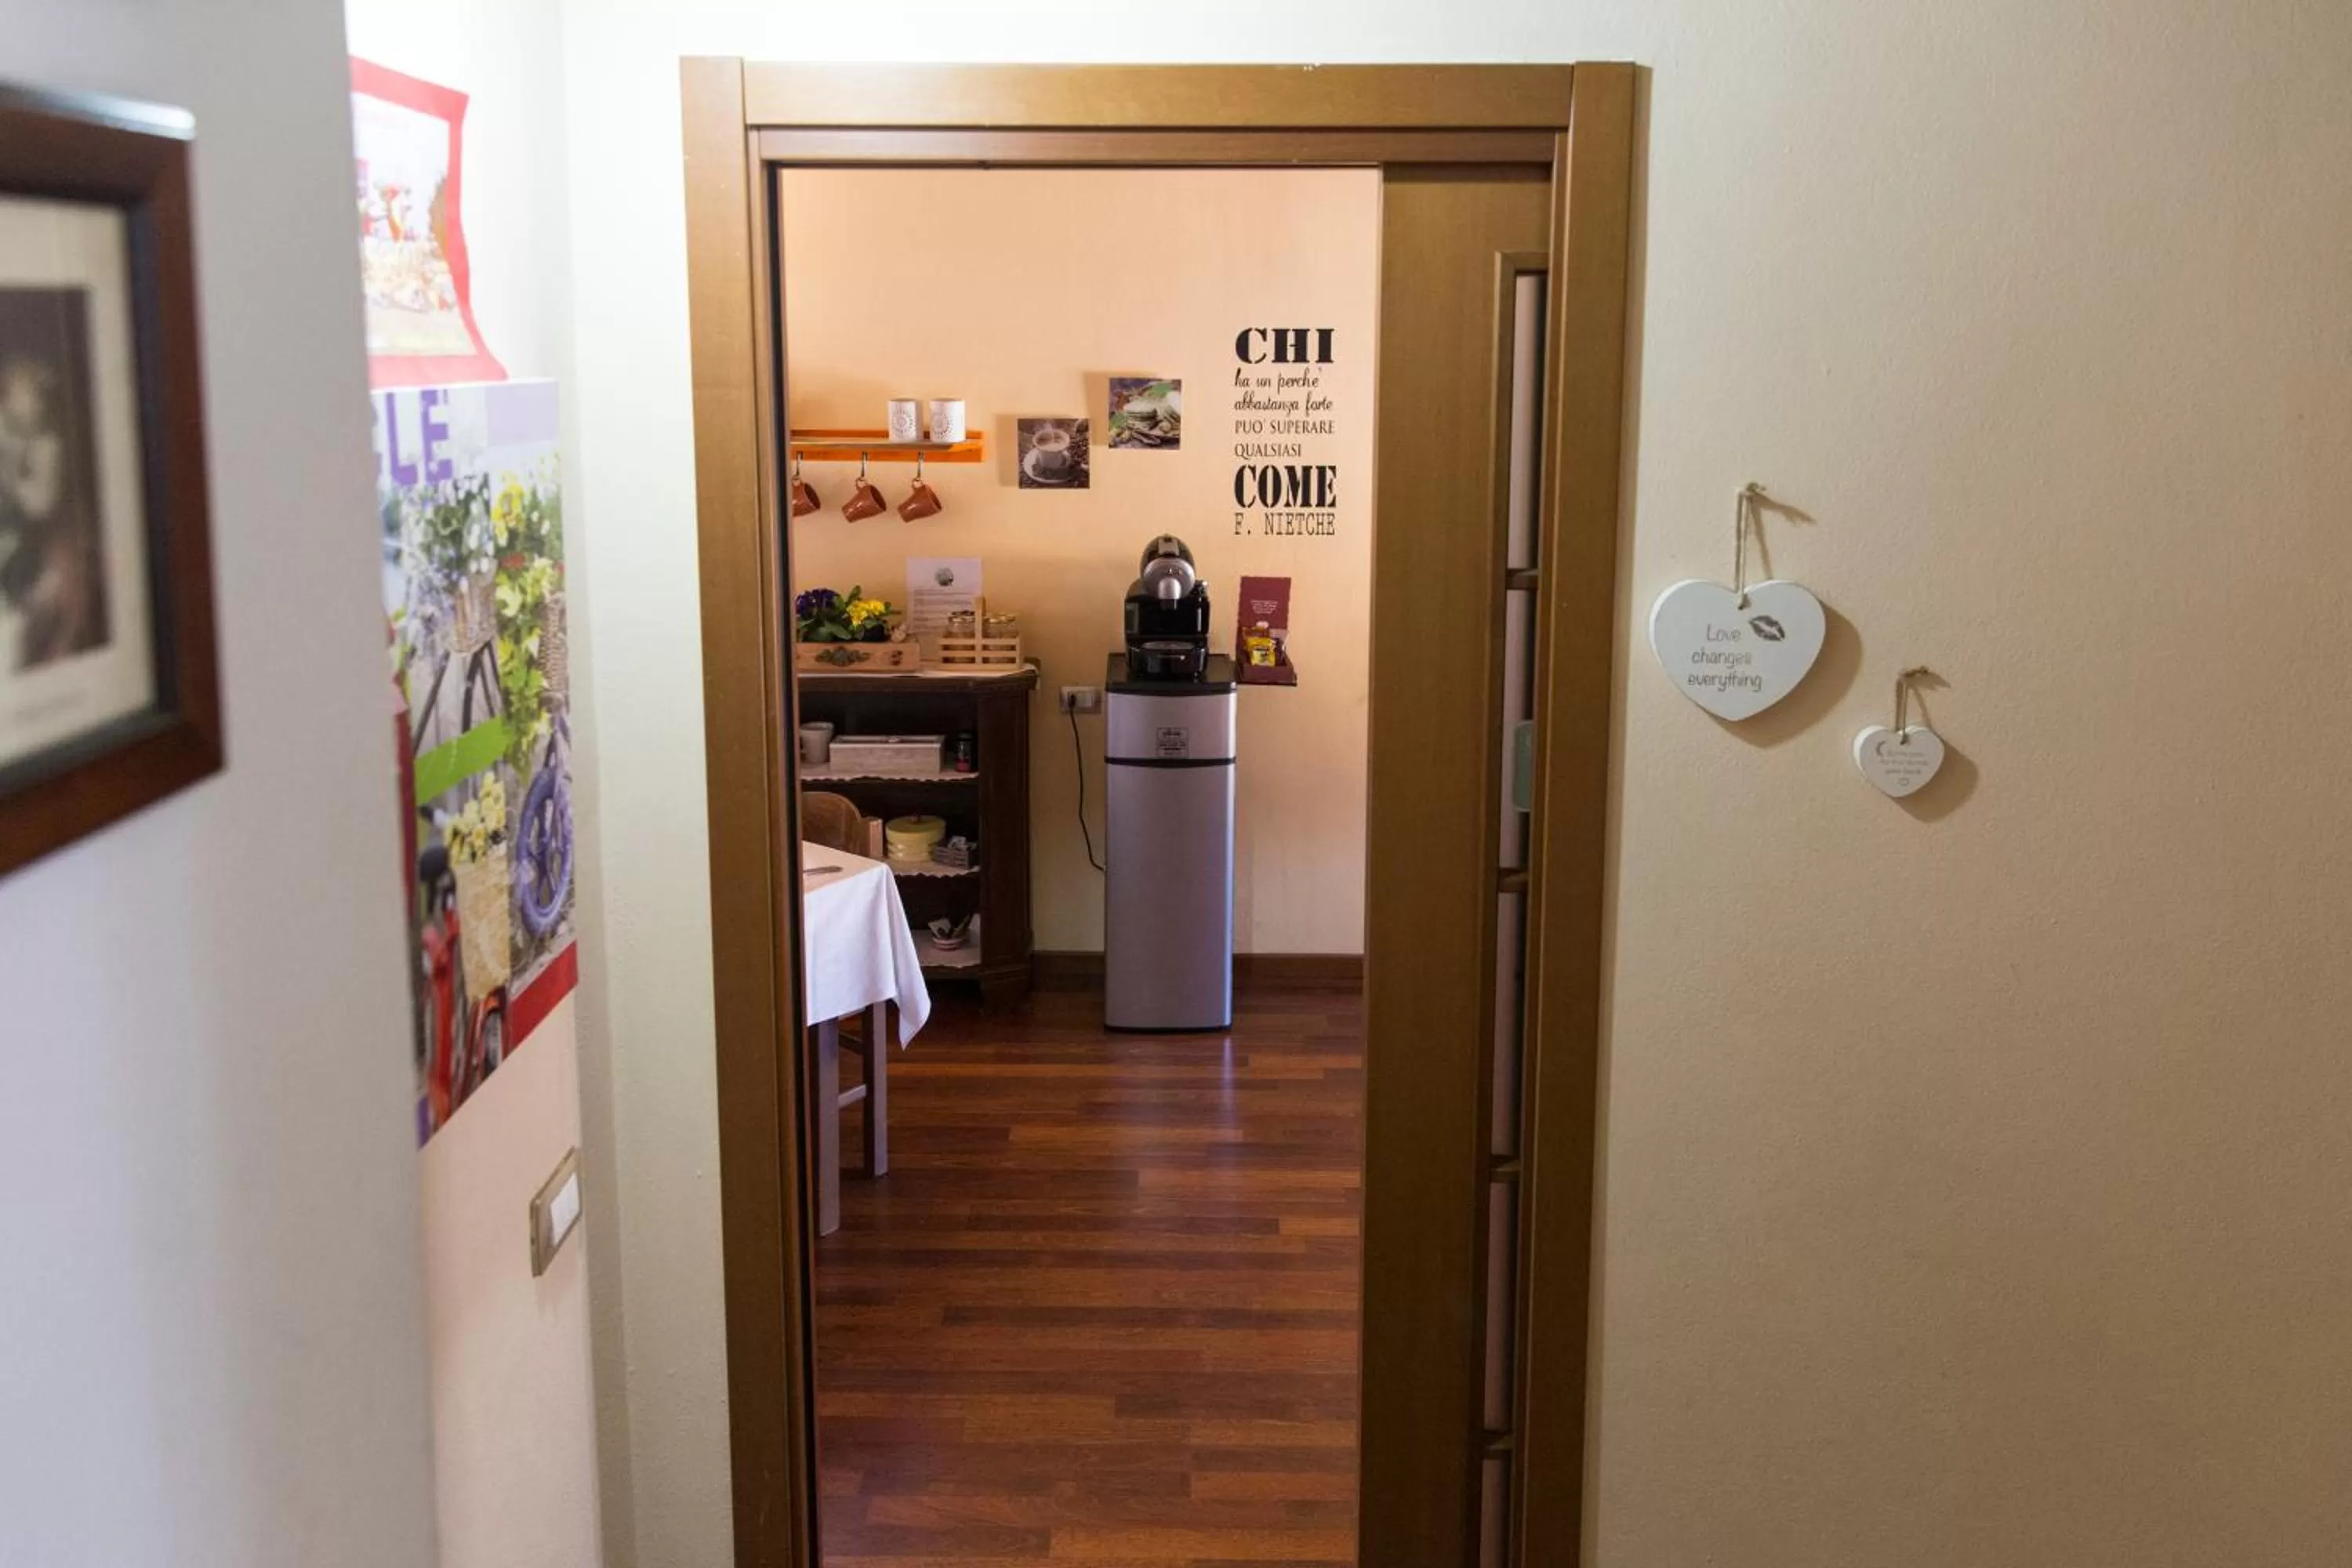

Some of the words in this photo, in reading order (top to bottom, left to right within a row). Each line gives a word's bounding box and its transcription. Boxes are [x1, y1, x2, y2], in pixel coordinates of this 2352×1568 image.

[1235, 327, 1335, 365] CHI
[1234, 367, 1250, 388] ha
[1255, 376, 1272, 388] un
[1234, 390, 1300, 417] abbastanza
[1305, 390, 1333, 416] forte
[1269, 419, 1336, 434] SUPERARE
[1234, 442, 1302, 460] QUALSIASI
[1233, 464, 1337, 509] COME
[1234, 512, 1251, 535] F.
[1264, 512, 1335, 535] NIETCHE
[1706, 624, 1741, 641] Love
[1691, 647, 1753, 669] changes
[1687, 672, 1762, 692] everything
